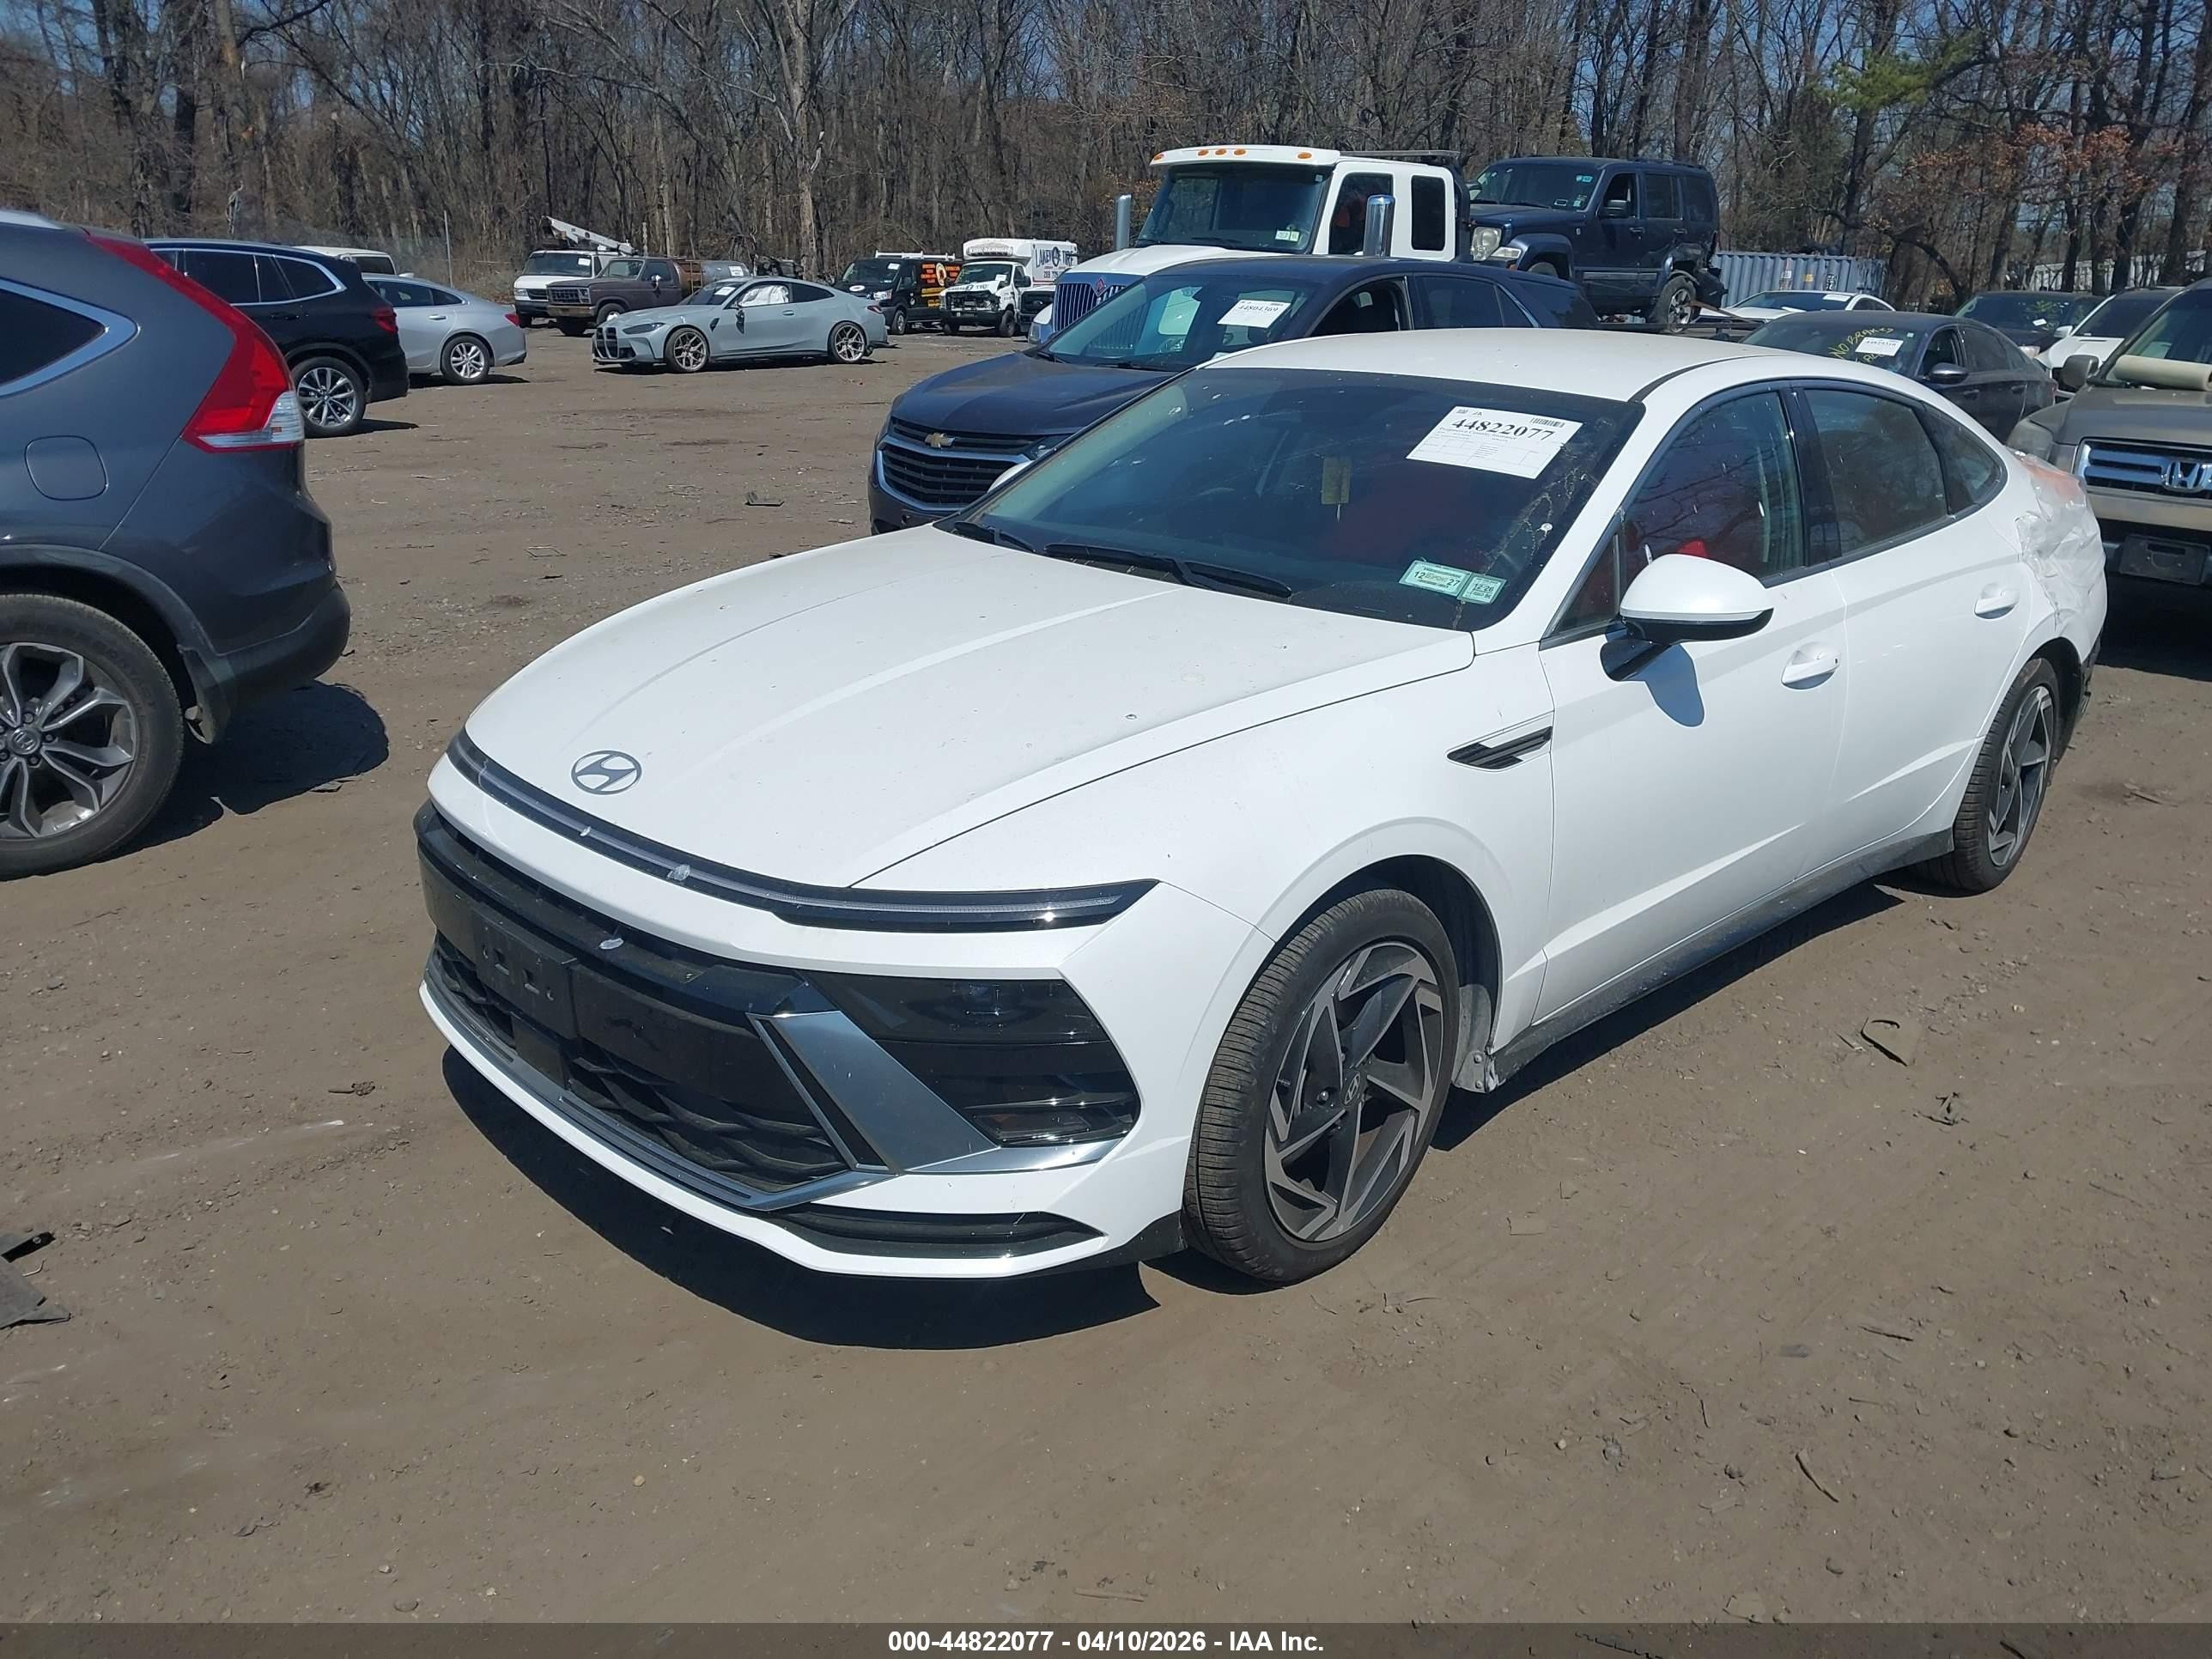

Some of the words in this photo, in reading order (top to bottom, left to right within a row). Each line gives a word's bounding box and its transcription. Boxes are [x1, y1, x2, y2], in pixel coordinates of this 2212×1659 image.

[1826, 343, 1850, 360] NO
[1451, 418, 1555, 441] 44822077
[1414, 571, 1425, 580] 12
[1446, 578, 1461, 587] 27
